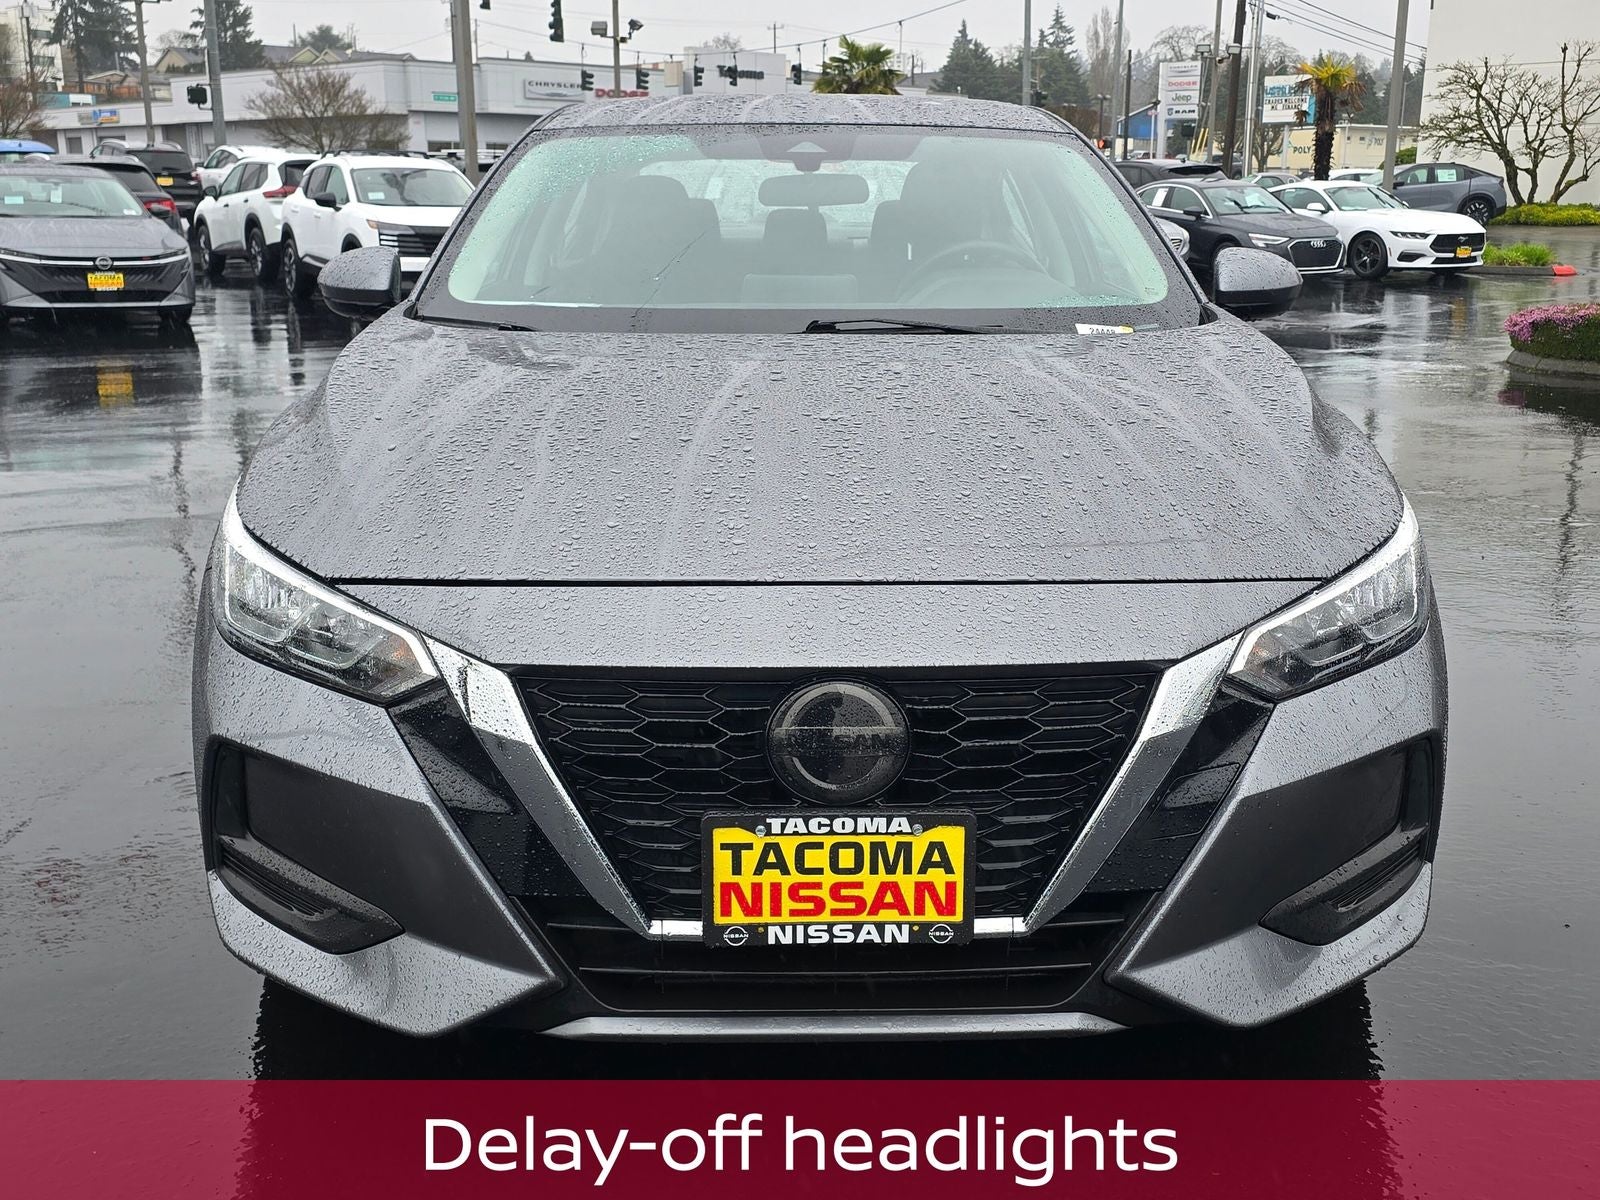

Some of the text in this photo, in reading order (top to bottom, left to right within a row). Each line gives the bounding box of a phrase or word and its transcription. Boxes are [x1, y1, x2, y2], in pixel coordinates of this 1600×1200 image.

[594, 88, 649, 98] DODGE
[1172, 93, 1192, 103] Jeep
[1293, 145, 1312, 154] POLY
[766, 817, 912, 835] TACOMA
[719, 840, 956, 876] TACOMA
[719, 881, 957, 918] NISSAN
[767, 923, 910, 945] NISSAN
